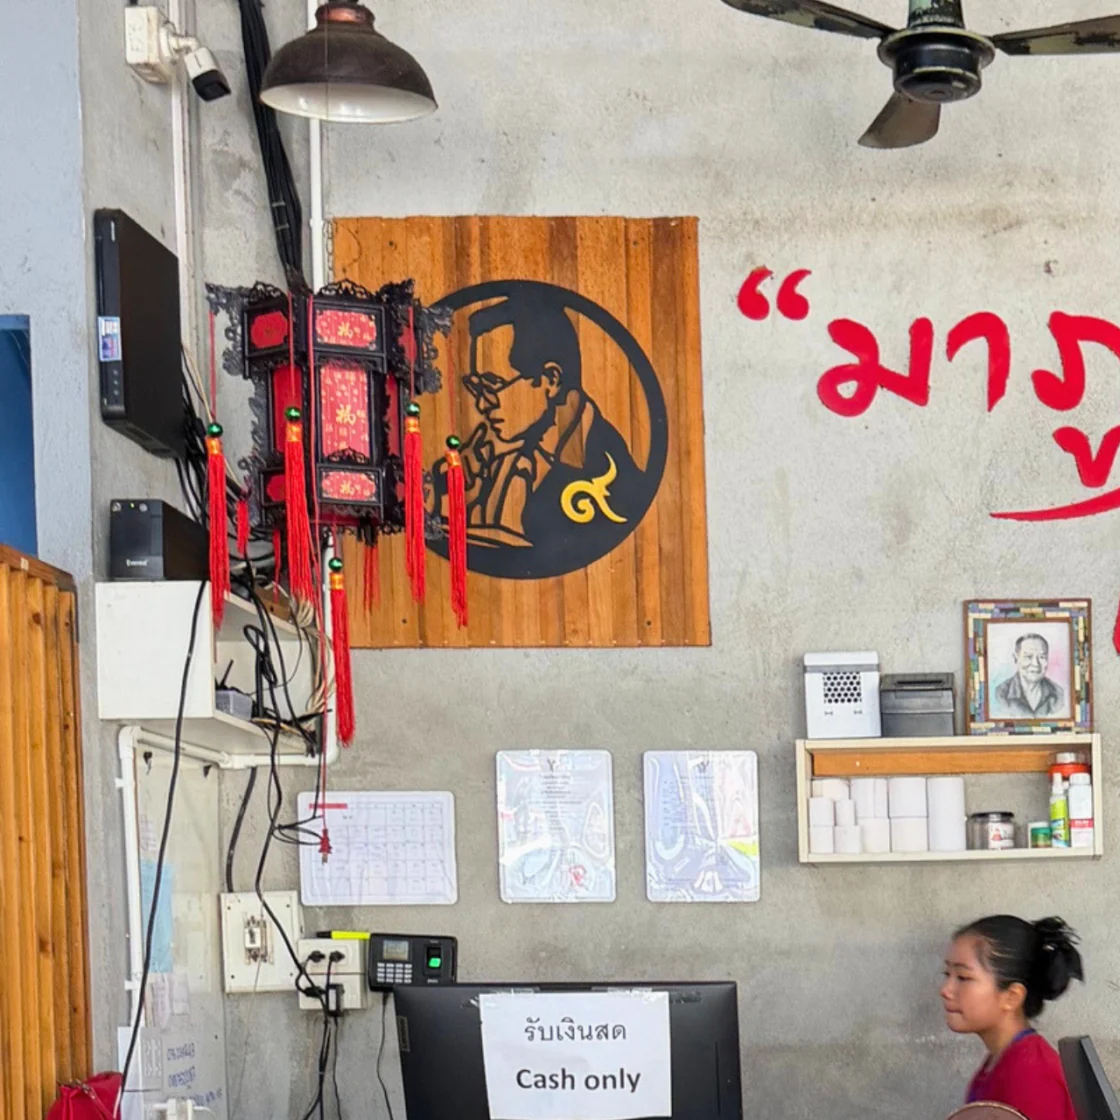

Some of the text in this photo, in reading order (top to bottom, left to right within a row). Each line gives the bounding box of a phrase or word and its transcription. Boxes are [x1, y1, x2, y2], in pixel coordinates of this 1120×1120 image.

[524, 1016, 627, 1042] รับเงินสด
[515, 1067, 641, 1093] Cash only
